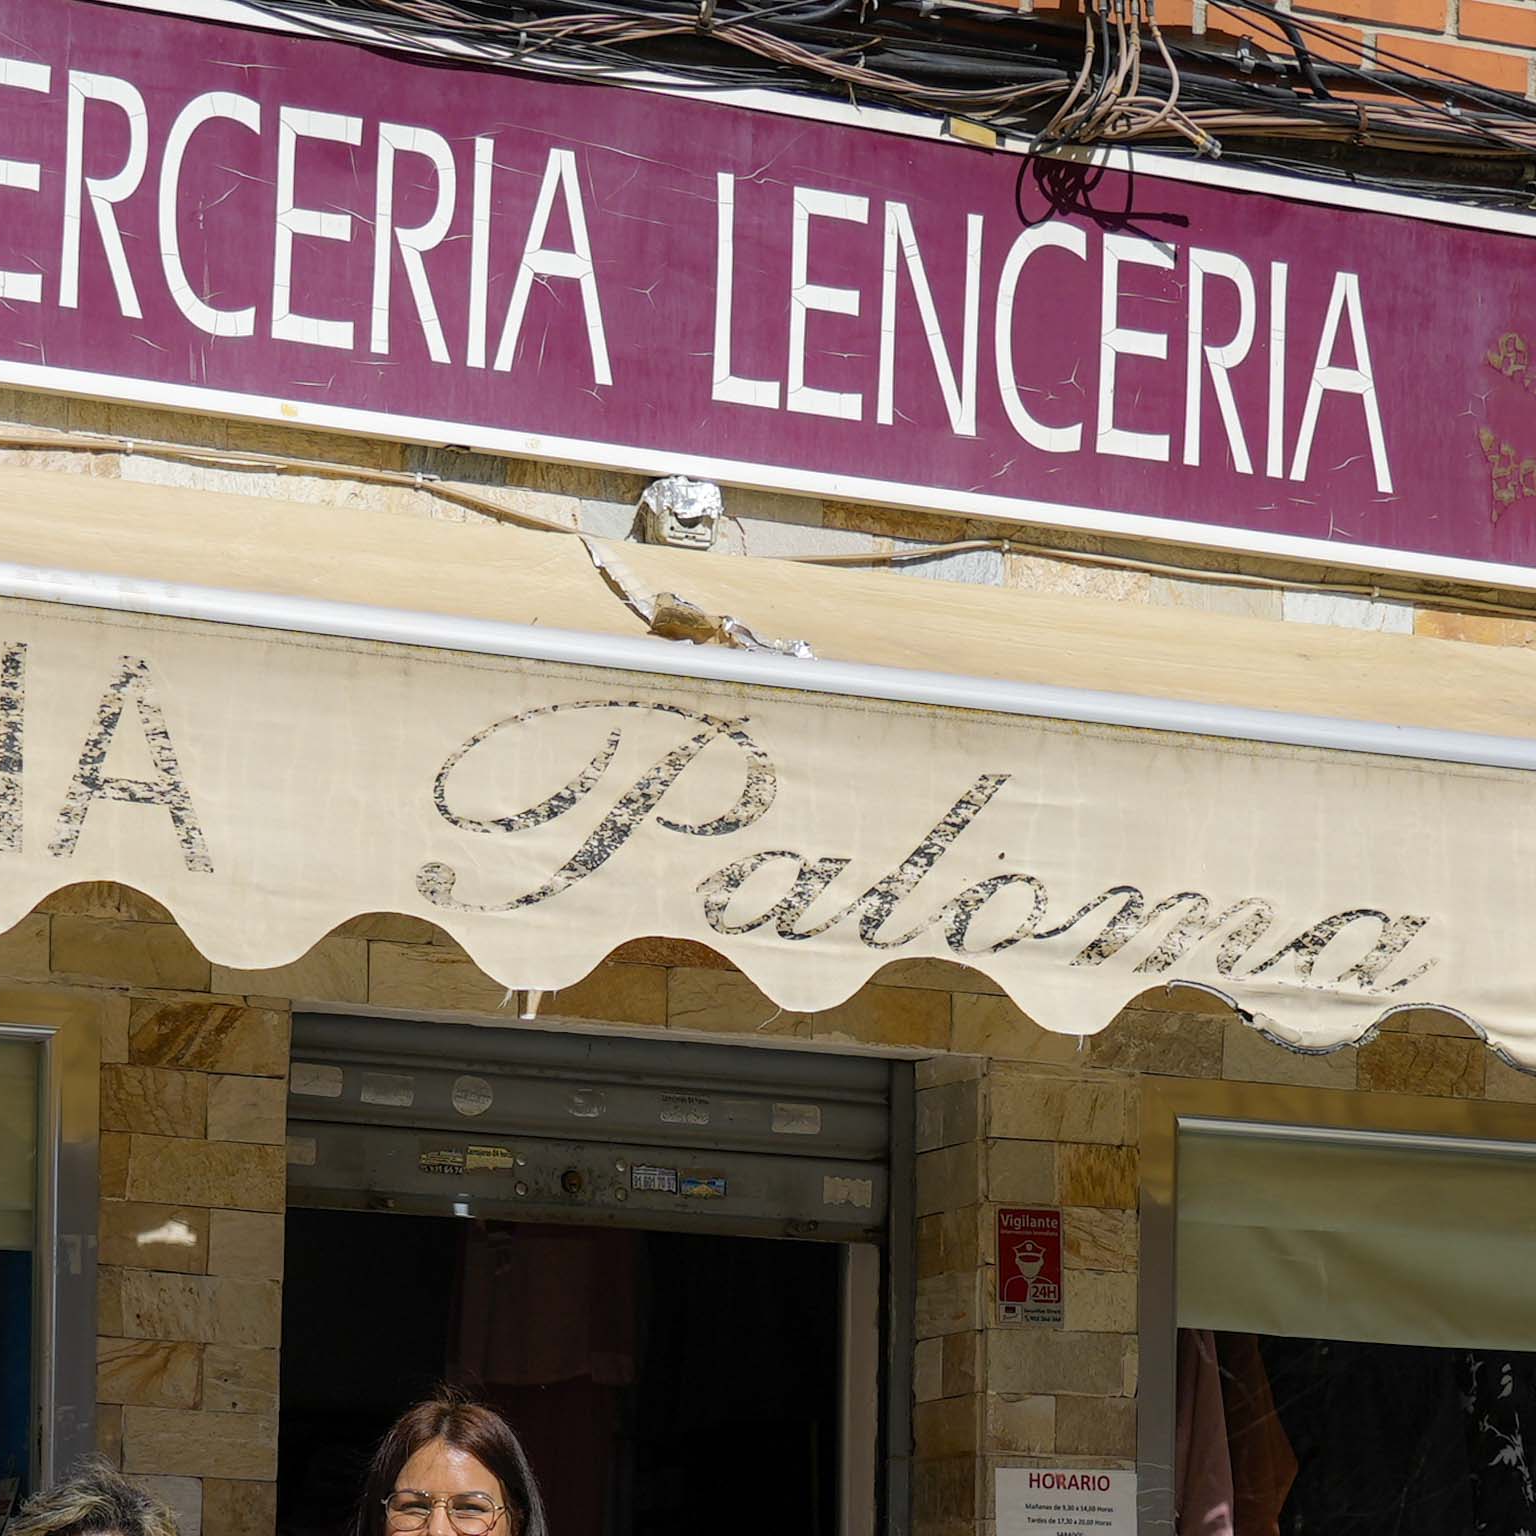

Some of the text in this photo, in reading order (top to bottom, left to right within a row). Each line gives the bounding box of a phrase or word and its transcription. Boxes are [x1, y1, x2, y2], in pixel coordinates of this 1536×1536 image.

[711, 170, 1395, 495] LENCERIA
[415, 698, 1440, 995] Paloma
[1000, 1213, 1059, 1231] Vigilante
[1031, 1285, 1057, 1299] 24H
[1028, 1472, 1111, 1492] HORARIO
